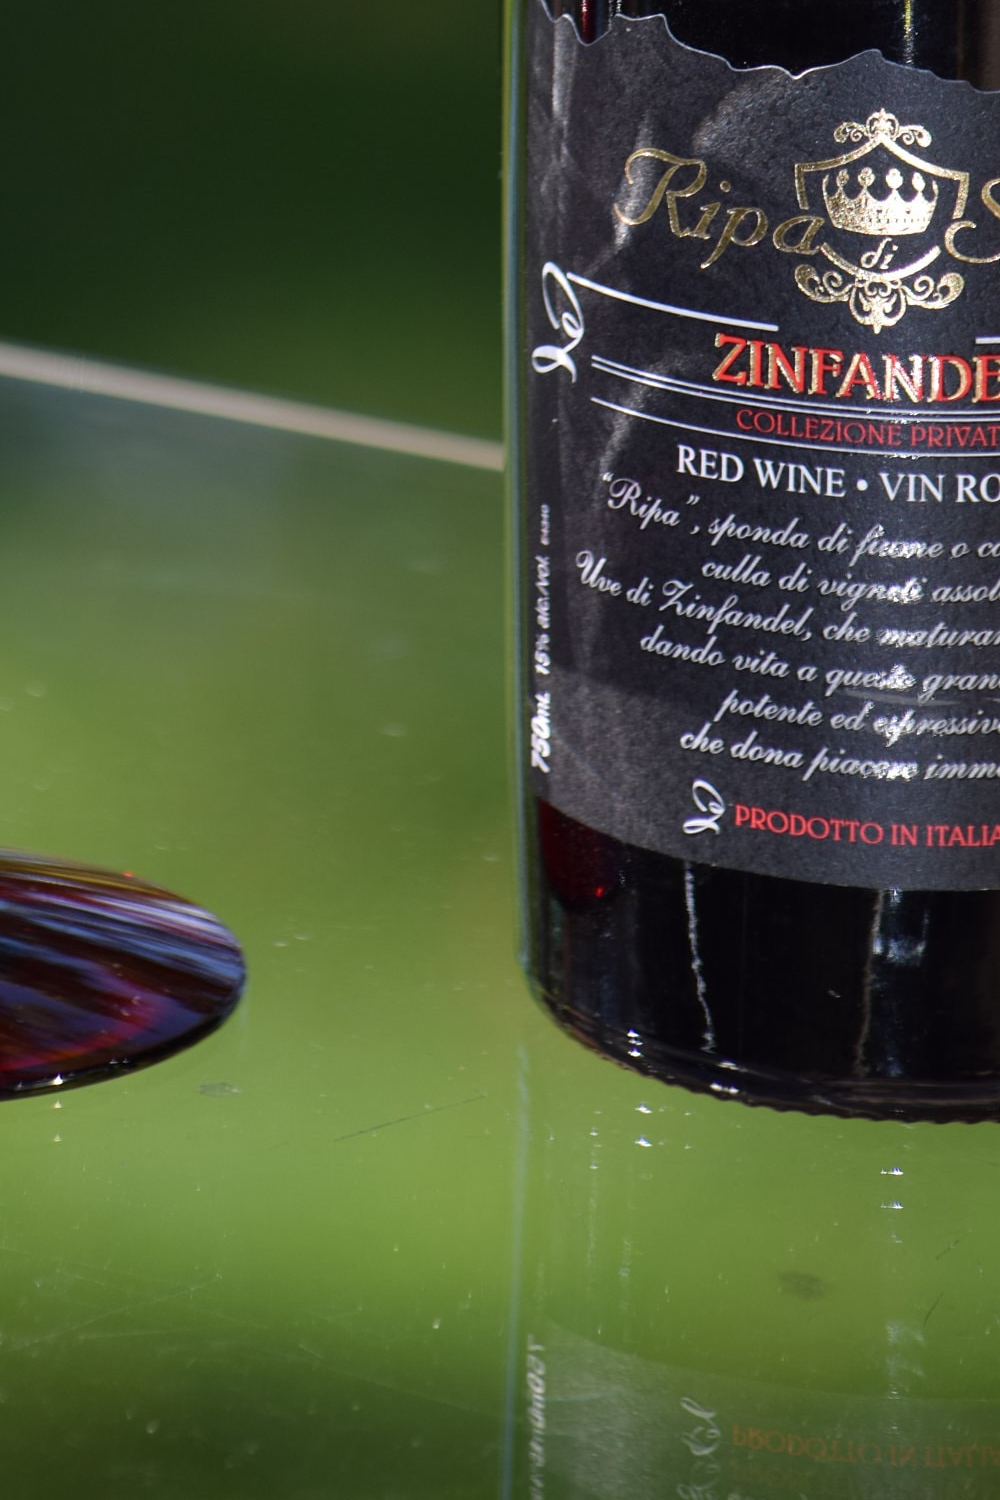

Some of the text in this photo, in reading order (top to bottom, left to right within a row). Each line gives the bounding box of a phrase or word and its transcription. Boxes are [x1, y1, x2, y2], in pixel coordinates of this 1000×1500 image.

[613, 147, 826, 270] Ripa
[860, 237, 900, 270] di
[712, 331, 1000, 404] ZINFANDE
[735, 408, 1000, 448] COLLEZIONE PRIVAT
[676, 444, 1000, 503] RED WINE VIN RO
[708, 513, 811, 549] sponda
[817, 522, 853, 555] di
[848, 523, 944, 567] fiume
[951, 541, 971, 559] o
[575, 550, 622, 596] Uve
[626, 576, 654, 607] di
[659, 579, 815, 642] Zinfandel,
[822, 611, 871, 643] che
[701, 553, 771, 587] culla
[779, 562, 812, 593] di
[817, 573, 928, 612] vigneti
[639, 623, 727, 667] dando
[731, 649, 791, 679] vita
[797, 664, 819, 683] a
[917, 673, 1000, 706] gran
[712, 687, 1000, 748] potente ed espressiv
[680, 721, 1000, 782] che dona piacere imm
[733, 804, 1000, 847] PRODOTTO IN ITALIA
